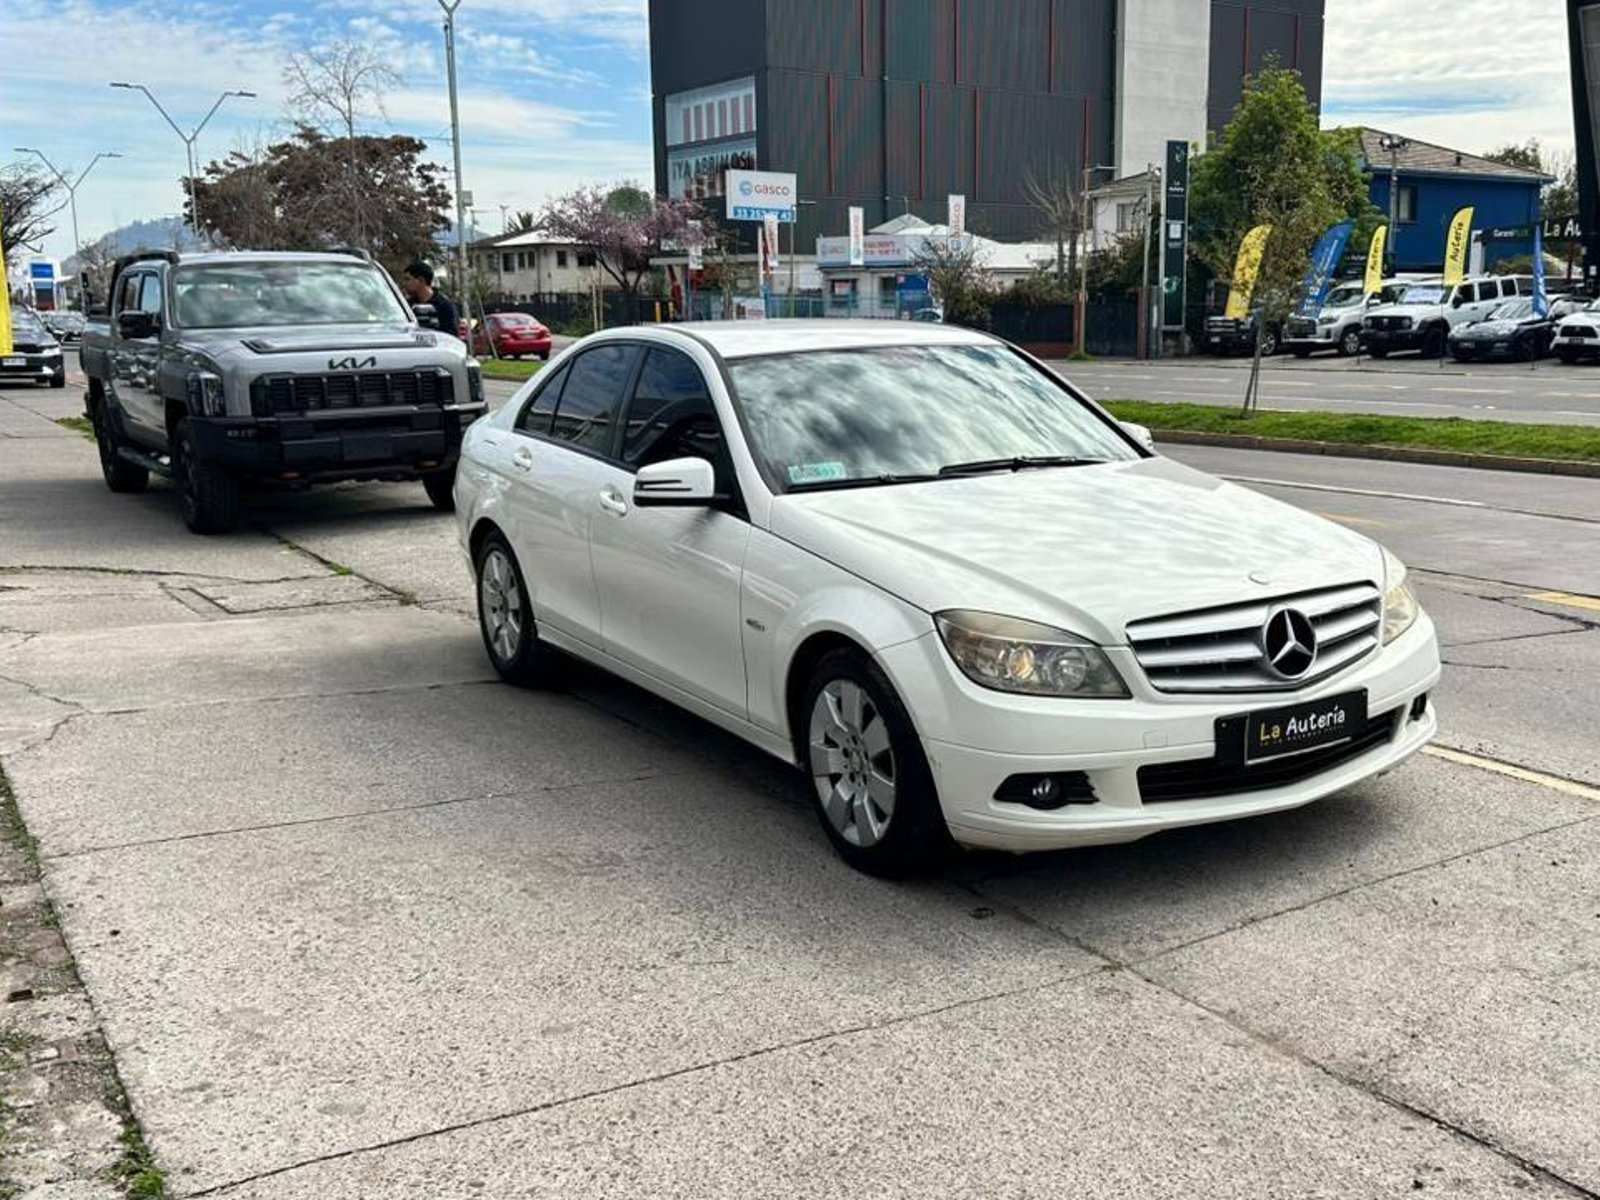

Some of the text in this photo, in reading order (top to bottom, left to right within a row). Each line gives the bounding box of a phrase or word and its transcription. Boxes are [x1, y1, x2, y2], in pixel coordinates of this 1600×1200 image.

[1543, 220, 1560, 237] La
[328, 356, 376, 370] KIA
[1260, 722, 1280, 741] La
[1286, 705, 1345, 736] Autería
